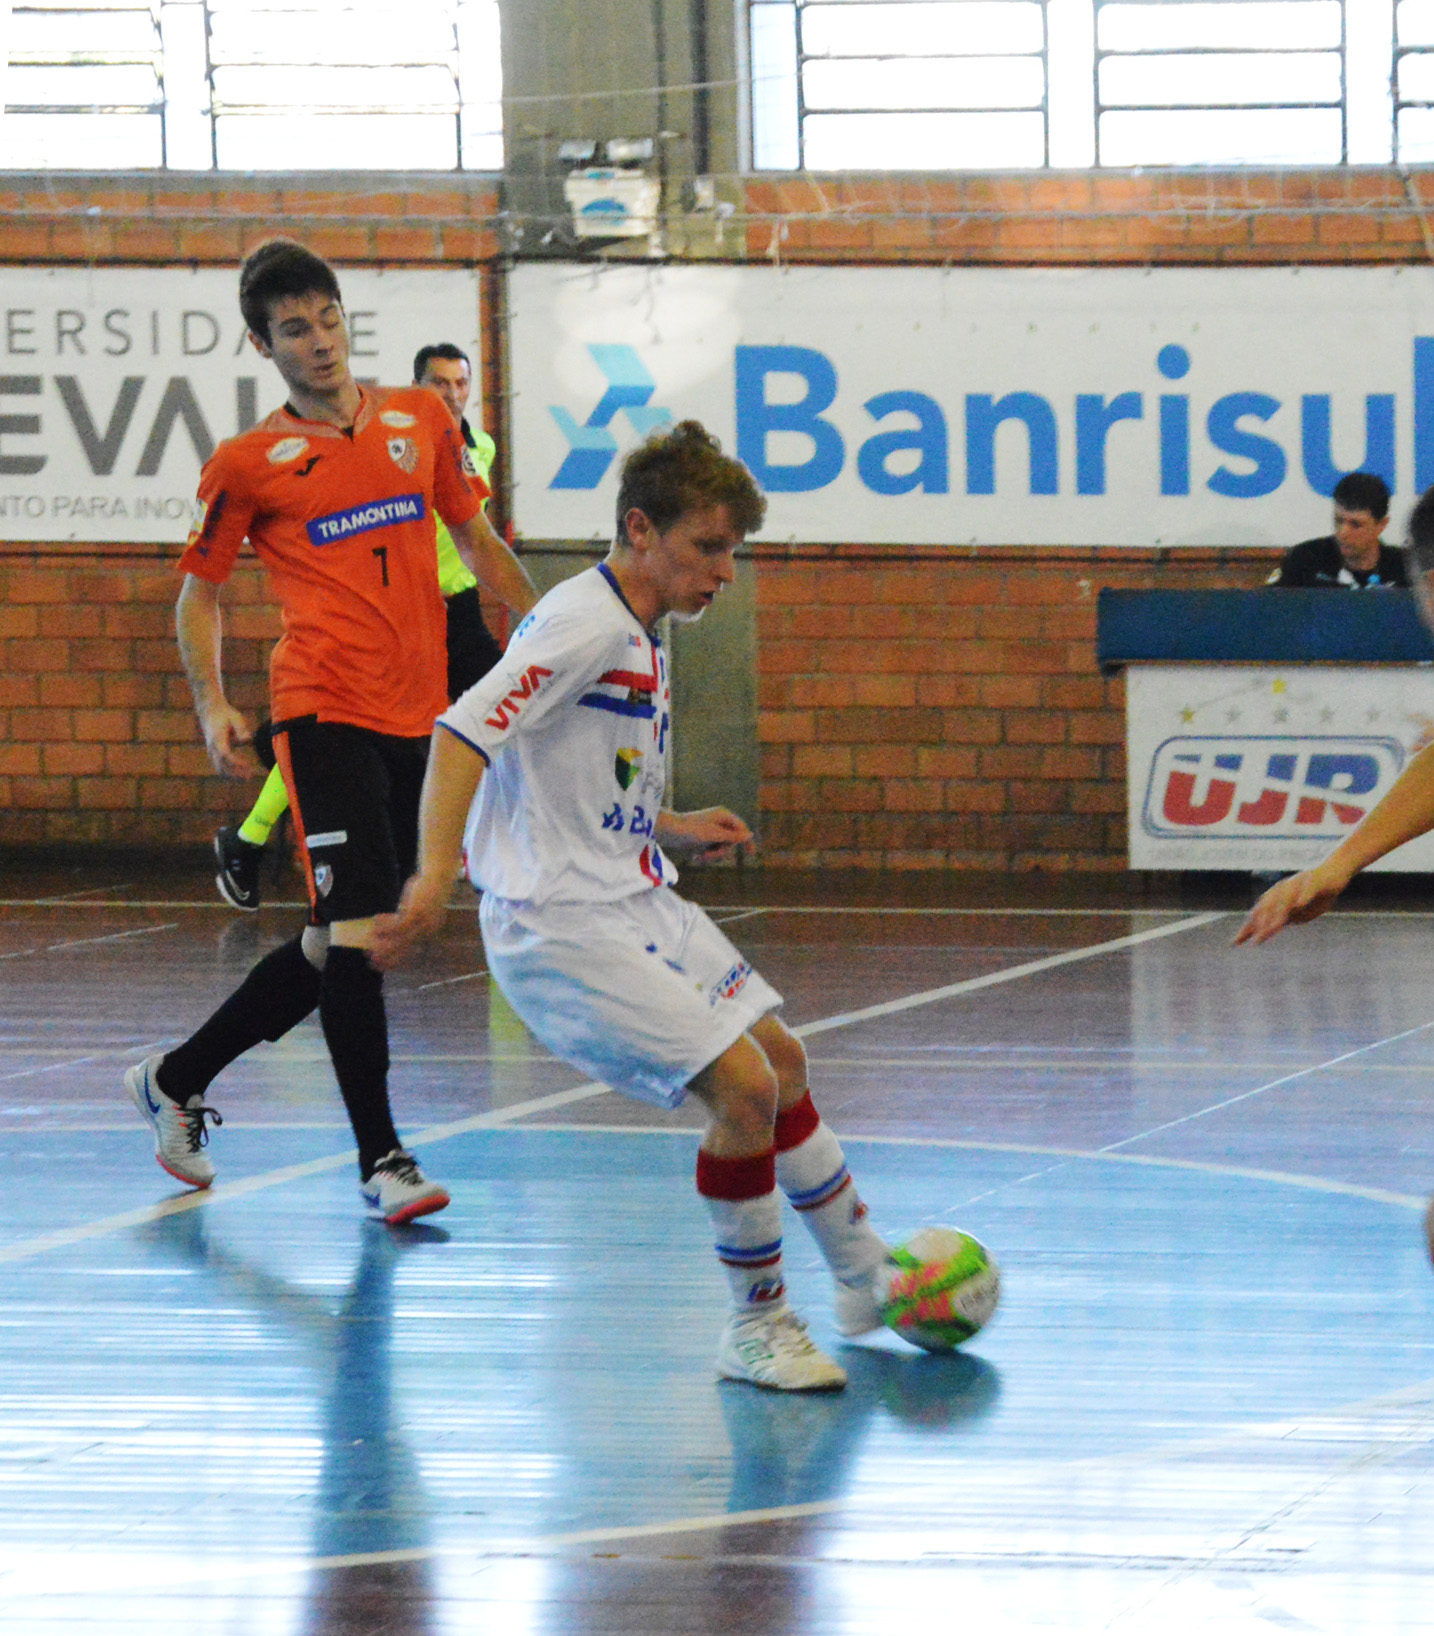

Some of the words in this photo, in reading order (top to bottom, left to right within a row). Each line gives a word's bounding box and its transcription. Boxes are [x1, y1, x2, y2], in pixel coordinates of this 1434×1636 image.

[53, 496, 128, 518] PARA
[318, 499, 418, 539] TRAMONTINA
[485, 665, 554, 731] VIVA
[1162, 753, 1380, 827] UJR
